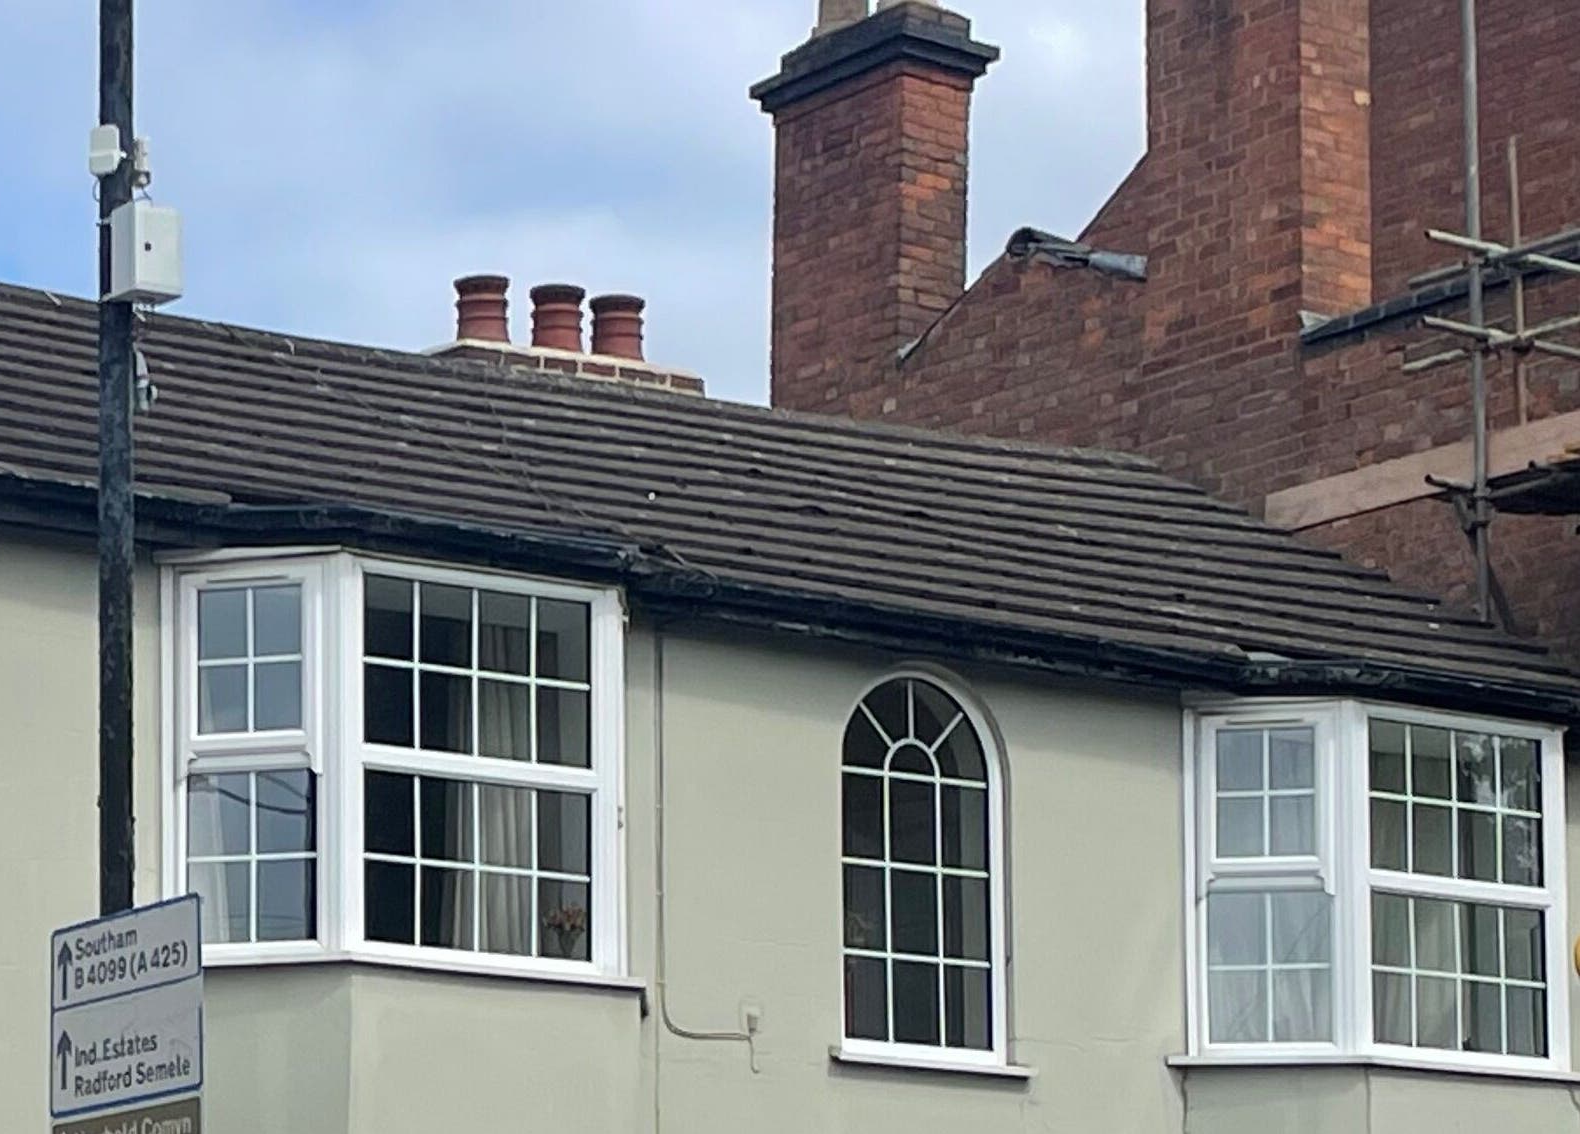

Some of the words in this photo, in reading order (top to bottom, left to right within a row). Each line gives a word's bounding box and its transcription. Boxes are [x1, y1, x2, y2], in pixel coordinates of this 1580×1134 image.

[75, 928, 137, 961] Southam
[74, 1064, 132, 1098] Radford
[136, 1054, 190, 1085] Semele
